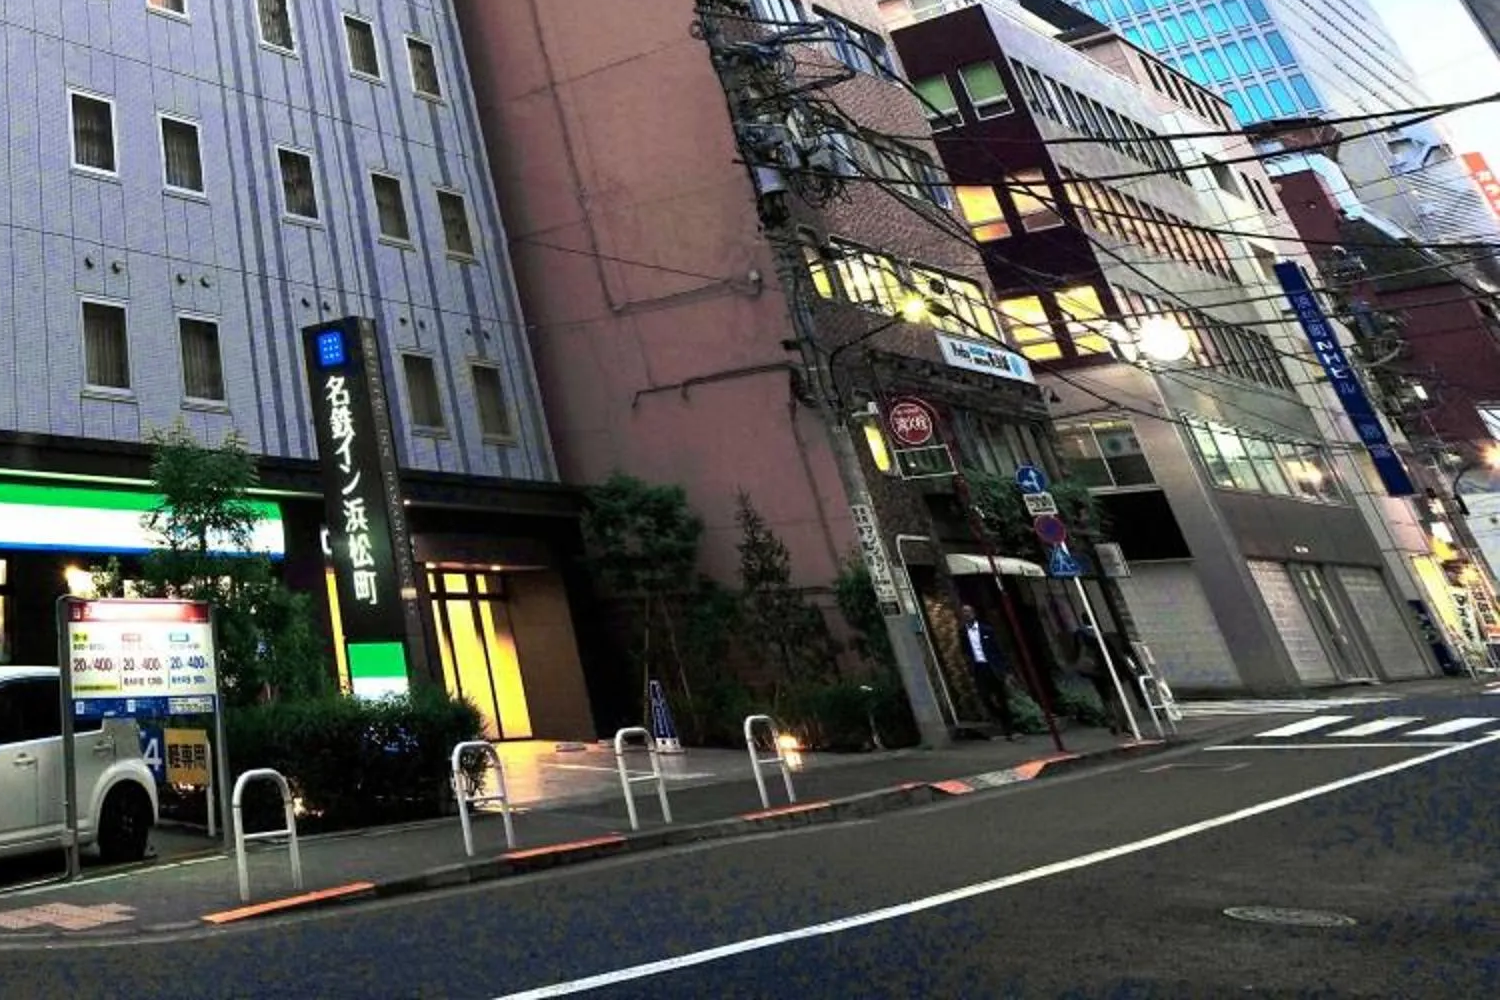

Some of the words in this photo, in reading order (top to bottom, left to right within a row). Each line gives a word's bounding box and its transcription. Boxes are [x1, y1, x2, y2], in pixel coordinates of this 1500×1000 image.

[324, 375, 378, 606] 名鉄イン浜松町
